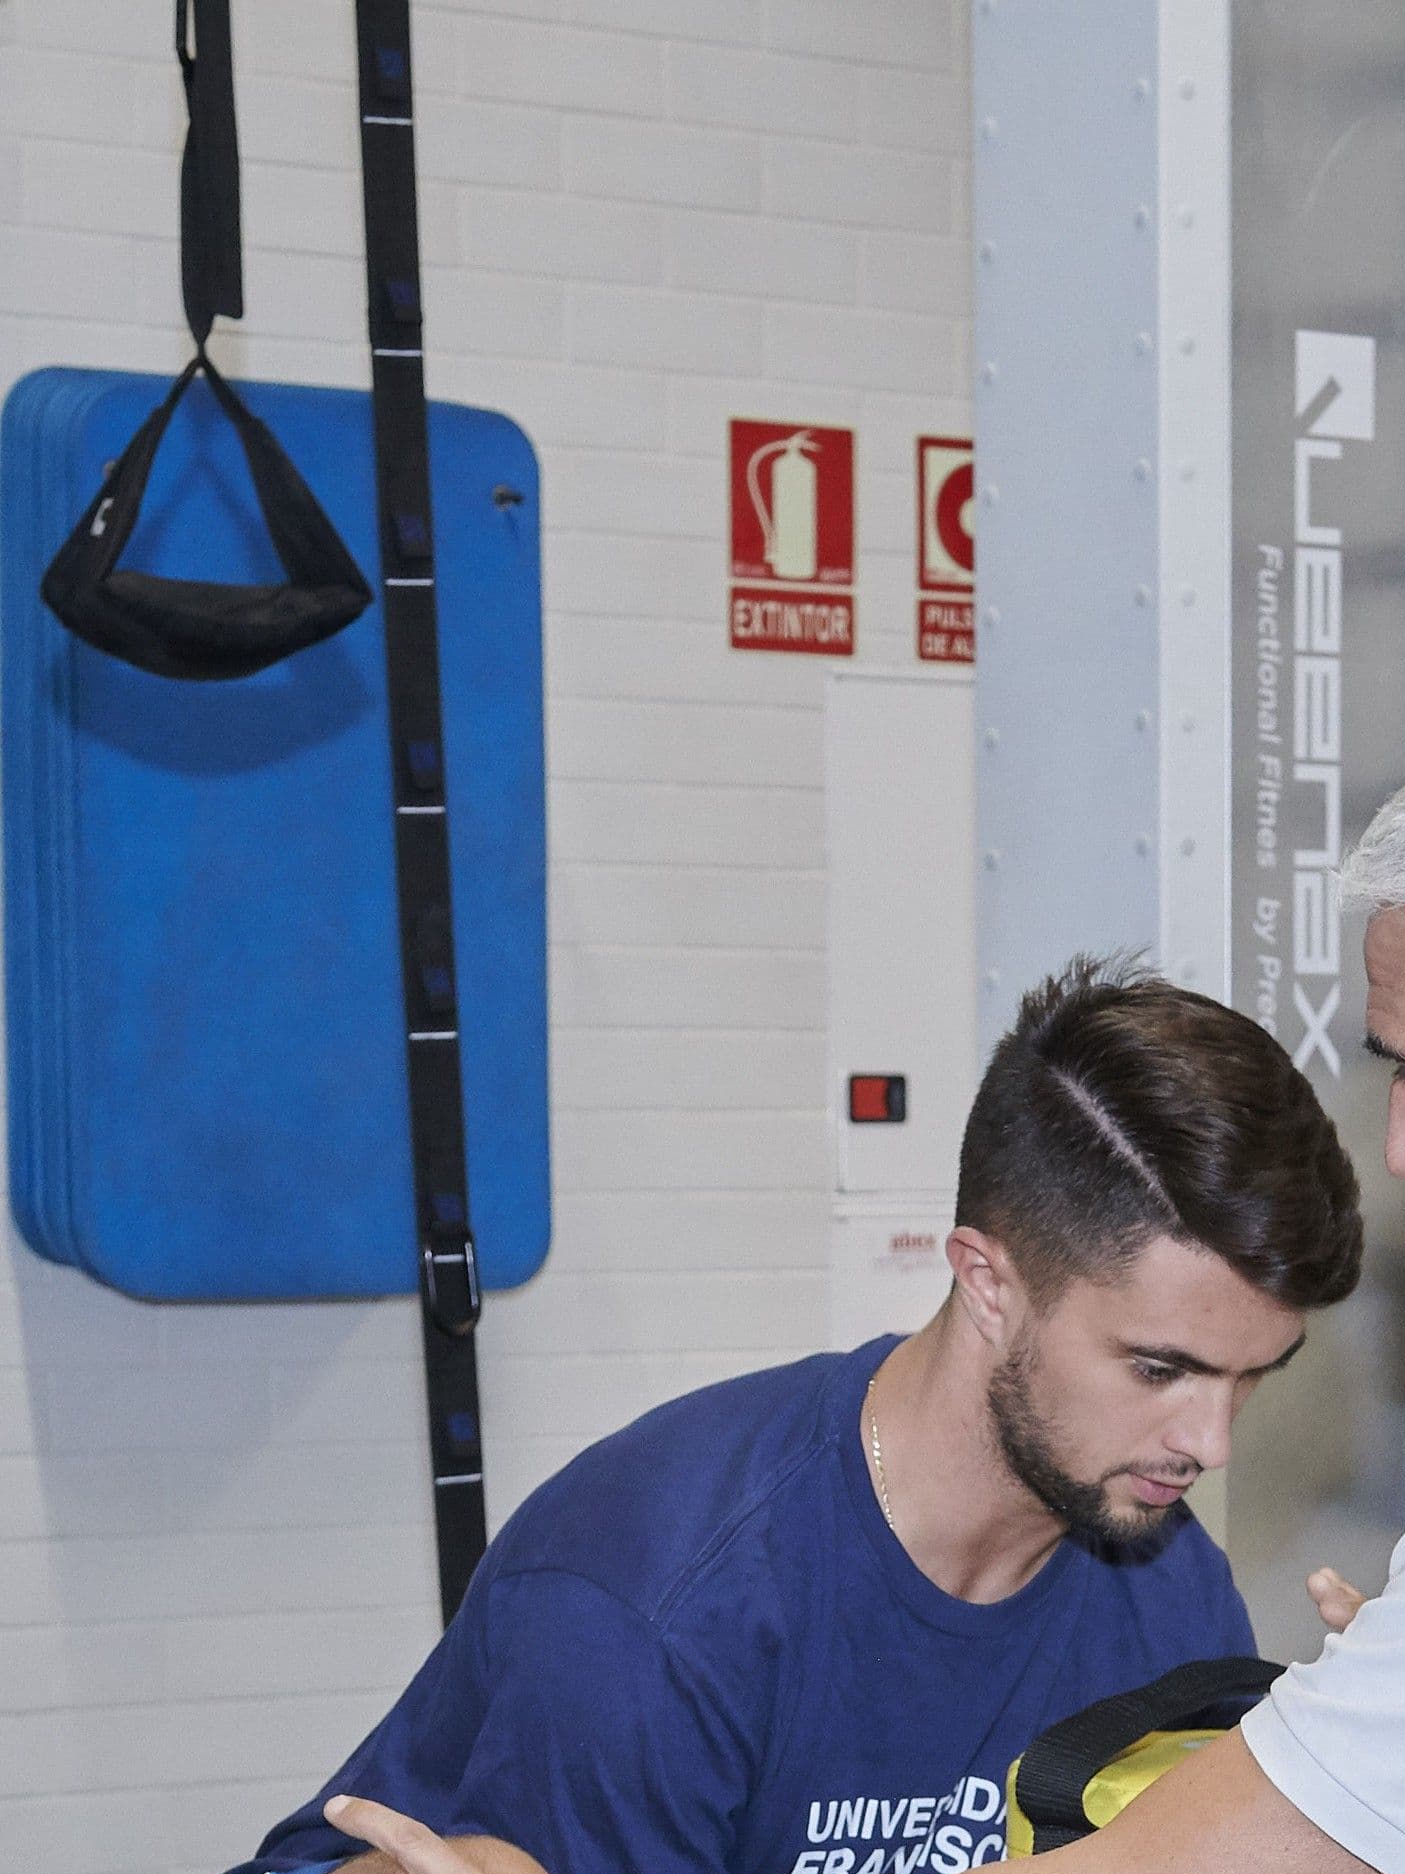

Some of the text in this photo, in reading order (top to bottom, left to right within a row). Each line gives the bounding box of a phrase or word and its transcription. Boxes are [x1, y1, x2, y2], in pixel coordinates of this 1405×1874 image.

[732, 597, 851, 643] EXTINTOR
[1256, 543, 1284, 745] Functional
[1252, 897, 1281, 944] by
